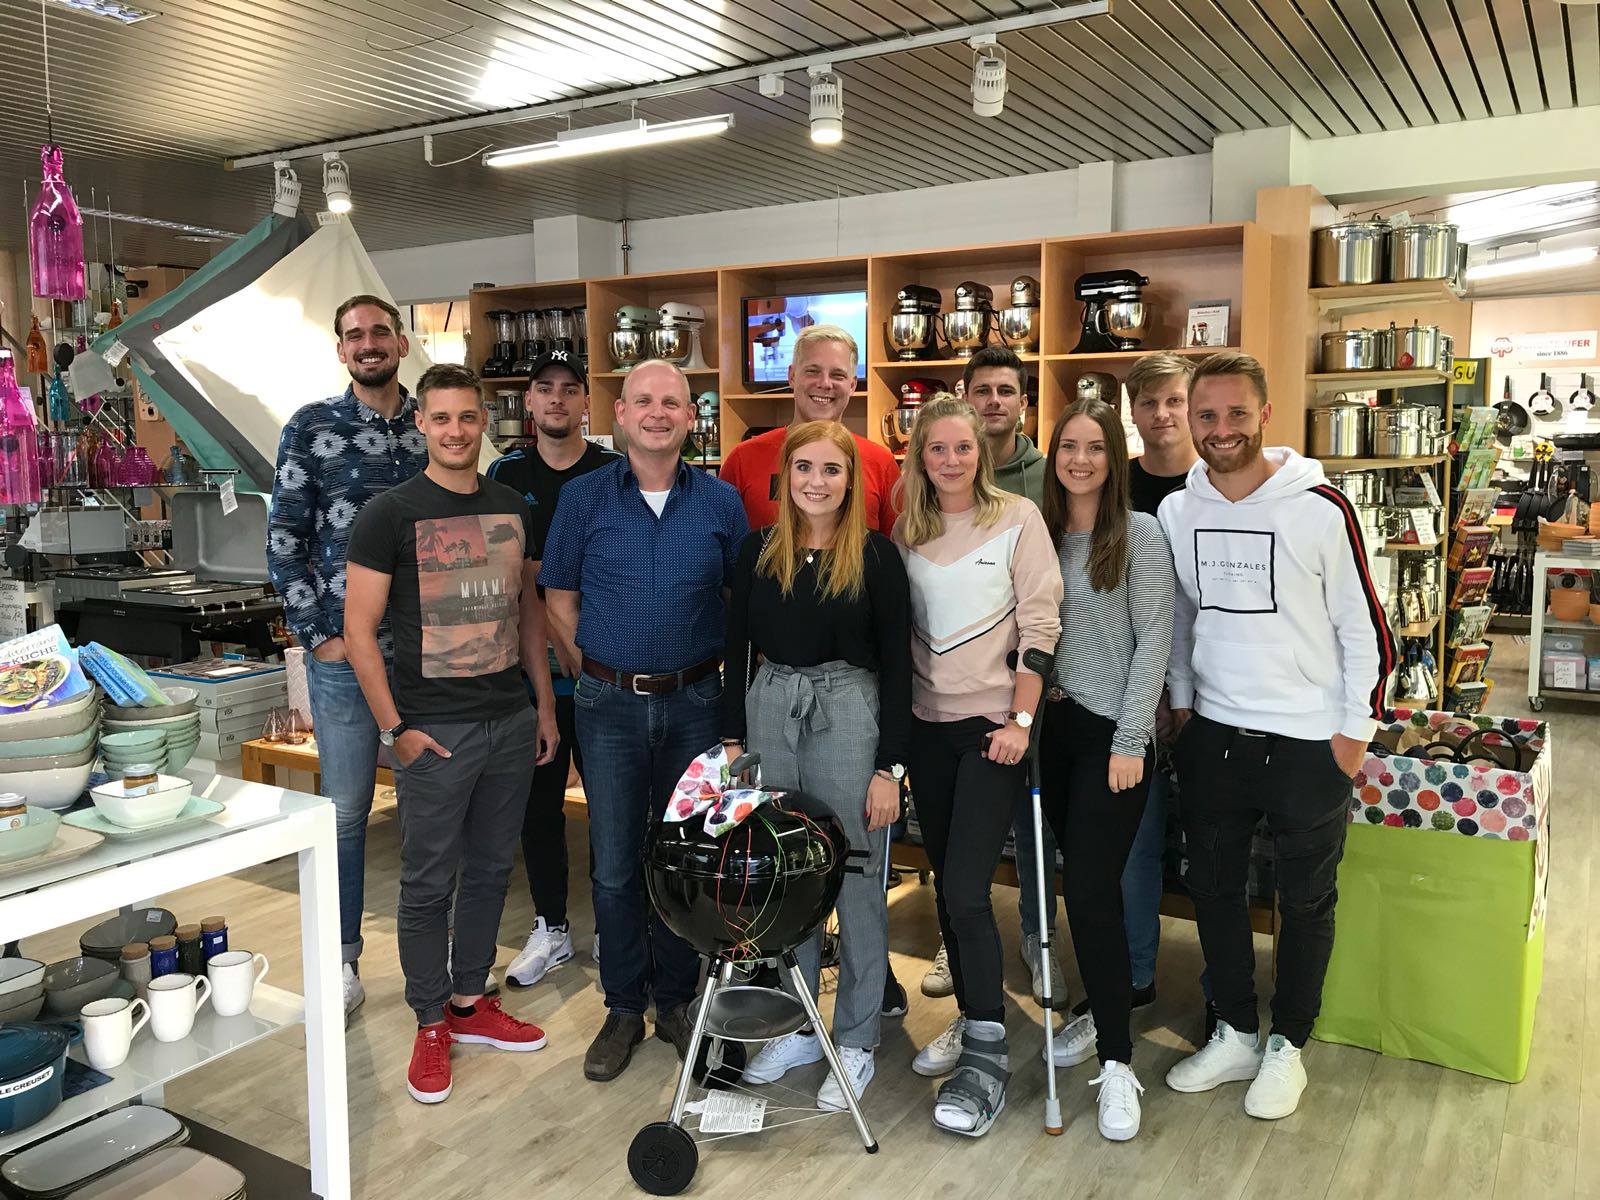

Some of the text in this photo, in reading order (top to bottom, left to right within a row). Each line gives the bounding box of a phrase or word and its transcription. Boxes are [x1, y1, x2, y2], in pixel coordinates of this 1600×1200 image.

[1453, 365, 1476, 380] GU
[460, 577, 508, 599] MIAMI
[0, 1070, 51, 1095] LE CREUSET
